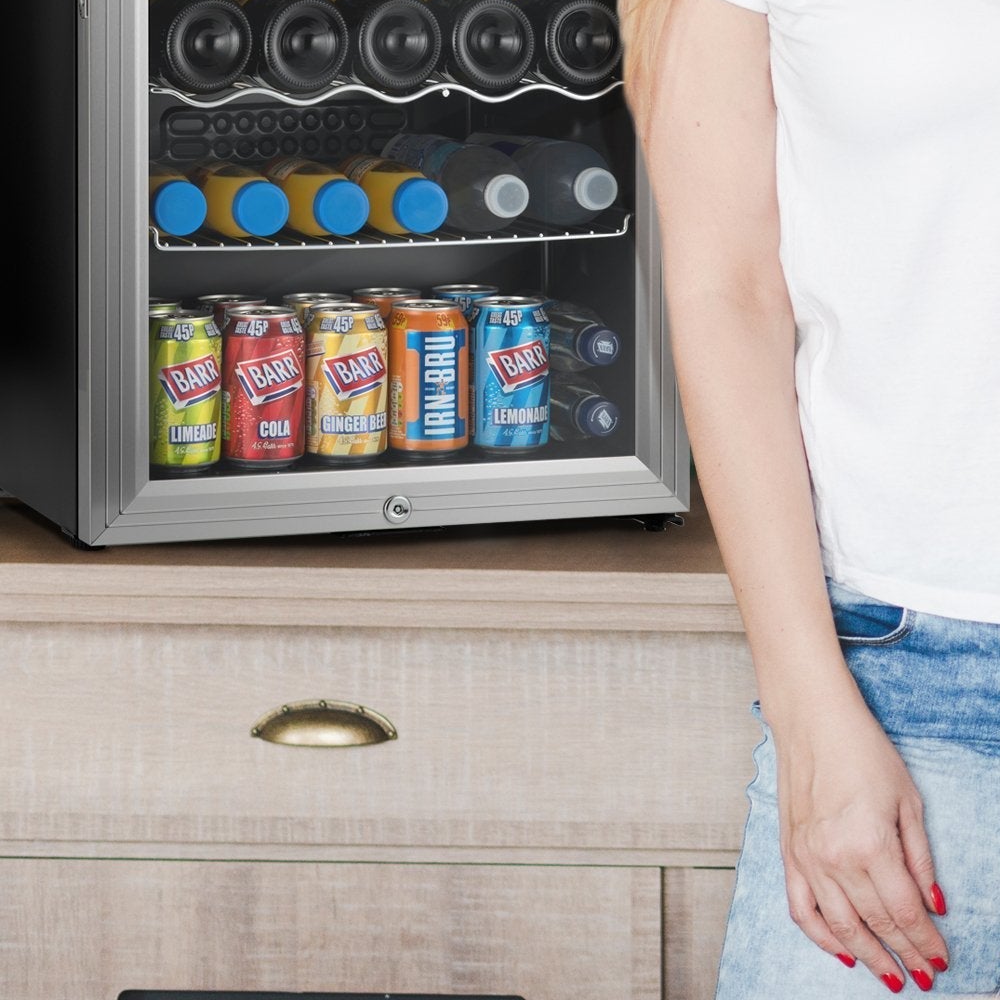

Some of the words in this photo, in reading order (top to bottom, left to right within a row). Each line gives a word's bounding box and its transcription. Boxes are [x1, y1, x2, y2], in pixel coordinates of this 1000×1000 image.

[333, 316, 354, 333] 45P
[503, 310, 523, 326] 45P
[173, 323, 195, 341] 45P
[247, 320, 269, 337] 45P
[334, 351, 384, 384] BARR
[499, 345, 547, 377] BARR
[170, 359, 219, 393] BARR
[248, 356, 300, 390] BARR
[425, 336, 455, 435] IRN-BRU
[322, 416, 368, 433] GINGER
[494, 406, 548, 425] LEMONADE
[170, 423, 217, 443] LIMEADE
[259, 420, 290, 438] COLA
